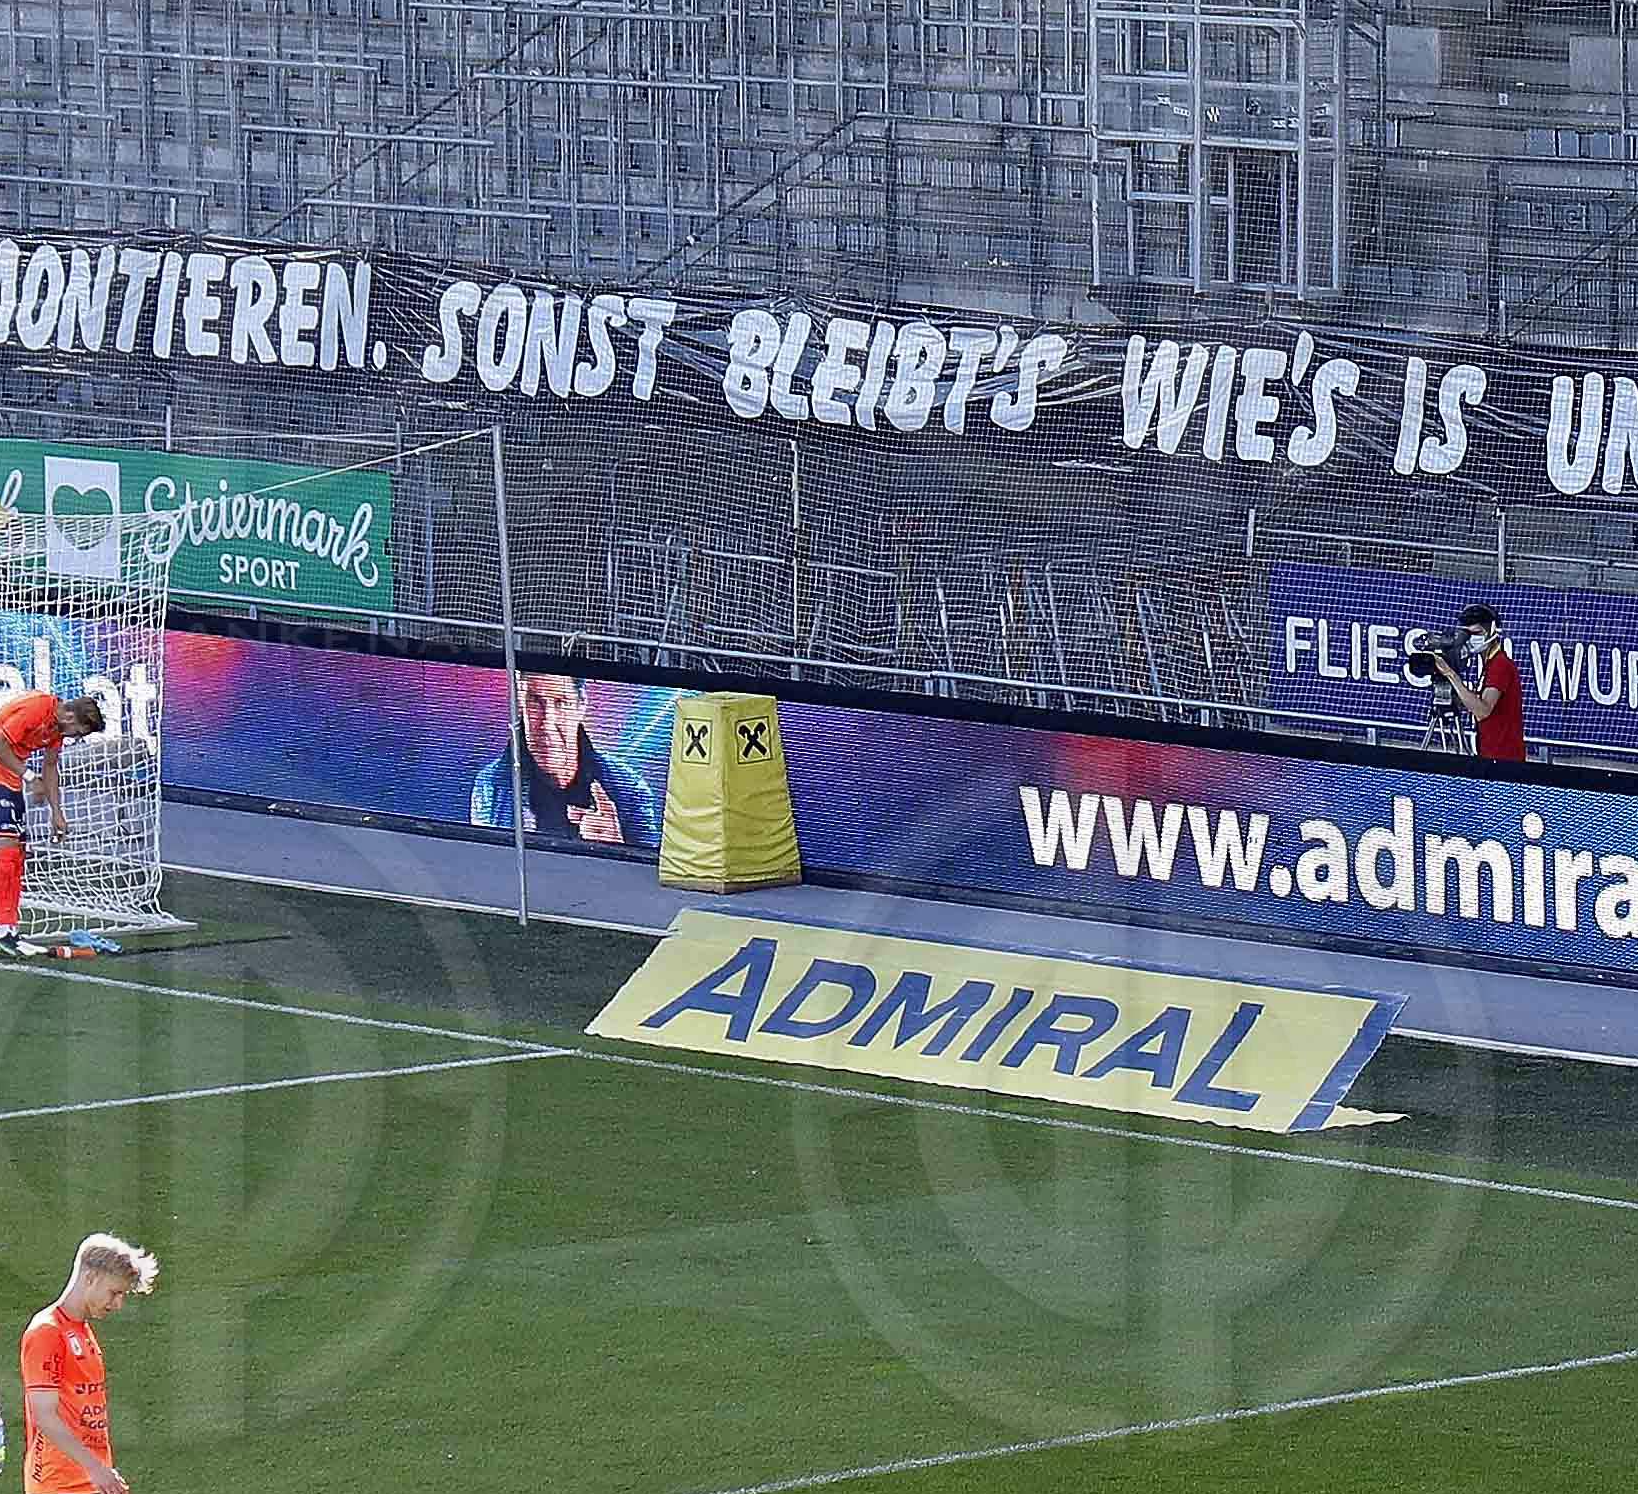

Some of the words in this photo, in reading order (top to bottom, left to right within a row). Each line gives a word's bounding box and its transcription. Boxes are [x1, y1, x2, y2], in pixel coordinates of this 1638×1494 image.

[423, 280, 675, 400] SONST
[725, 310, 1072, 435] BLEIBT'S
[1121, 333, 1359, 468] WIE'S
[1393, 358, 1487, 475] IS
[143, 476, 379, 587] Steiermark
[219, 554, 300, 590] SPORT
[638, 935, 1266, 1113] ADMIRAL
